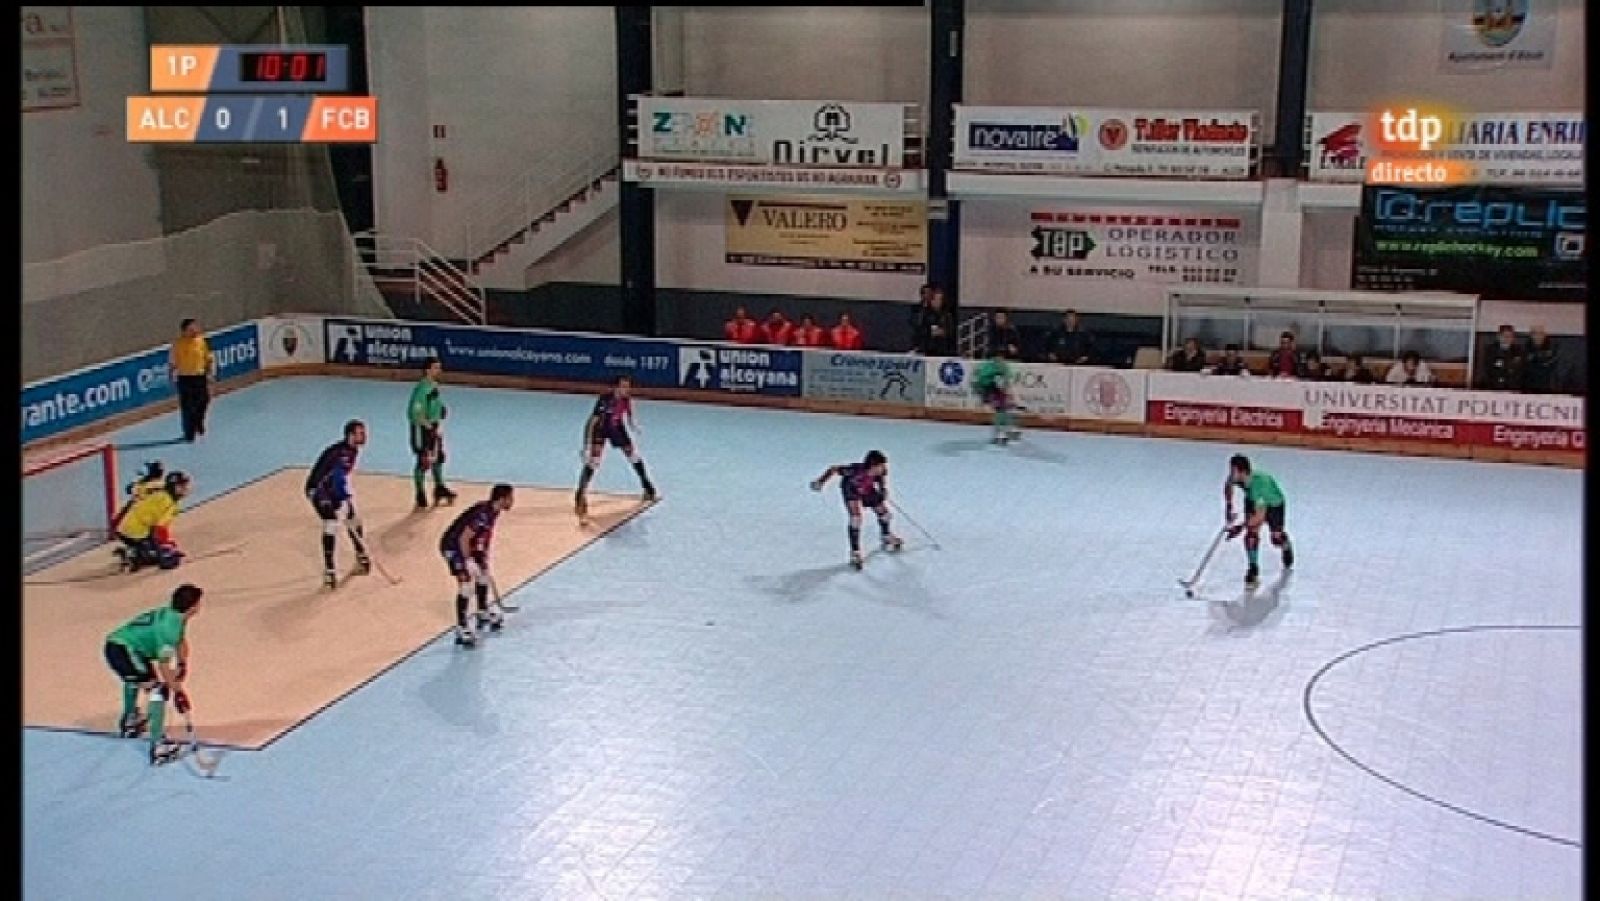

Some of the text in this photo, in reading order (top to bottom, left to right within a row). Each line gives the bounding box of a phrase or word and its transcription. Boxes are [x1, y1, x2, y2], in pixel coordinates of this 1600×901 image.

[975, 127, 1057, 149] novaire
[762, 208, 849, 232] VALERO
[1108, 228, 1238, 245] OPERADOR
[1105, 245, 1239, 263] LOGISTICO
[214, 337, 256, 368] uros
[640, 355, 669, 370] 1877
[719, 348, 770, 366] union
[719, 363, 798, 389] alcoyana
[1304, 388, 1445, 415] UNIVERSITAT
